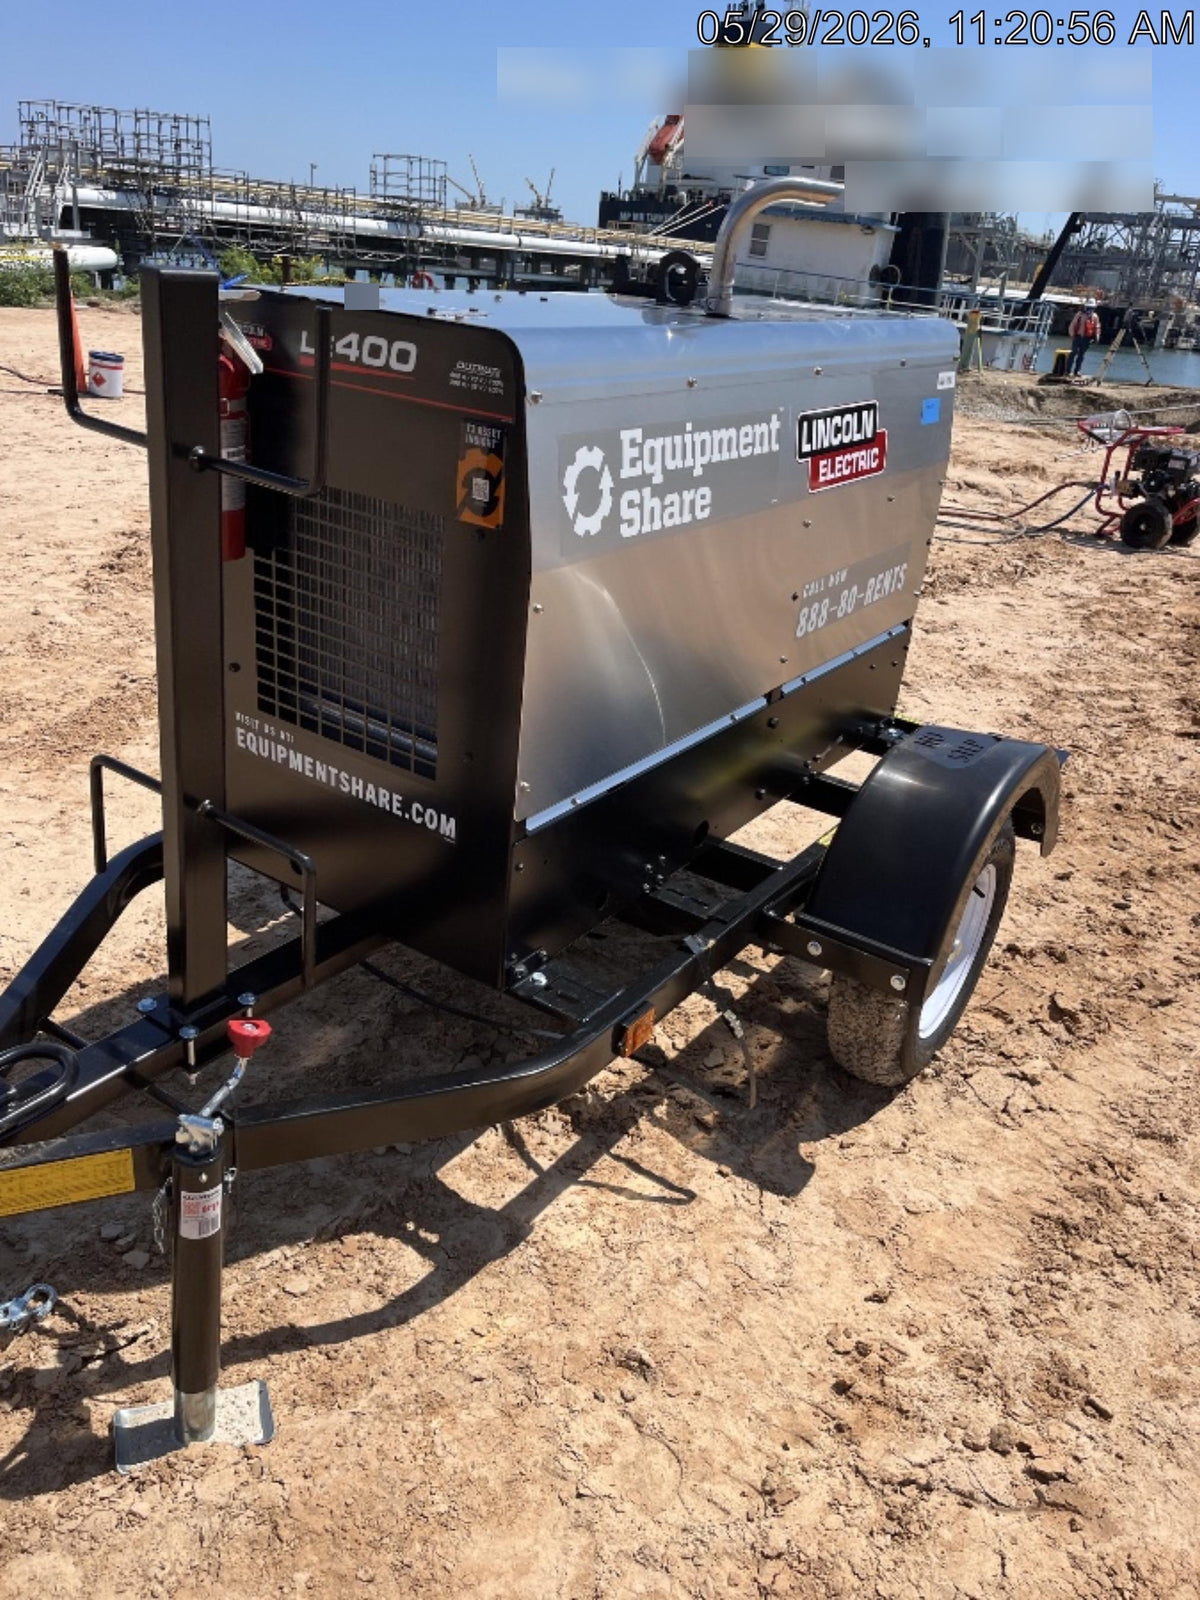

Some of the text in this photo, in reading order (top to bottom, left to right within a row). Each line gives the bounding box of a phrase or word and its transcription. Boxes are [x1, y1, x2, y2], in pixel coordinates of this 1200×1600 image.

[300, 330, 418, 373] L400
[620, 413, 780, 485] Equipment
[801, 408, 875, 453] LINCOLN
[818, 447, 881, 483] ELECTRIC
[620, 486, 711, 539] Share
[796, 562, 908, 638] 888-80-RENTS
[236, 726, 457, 841] EQUIPMENTSHARE.COM
